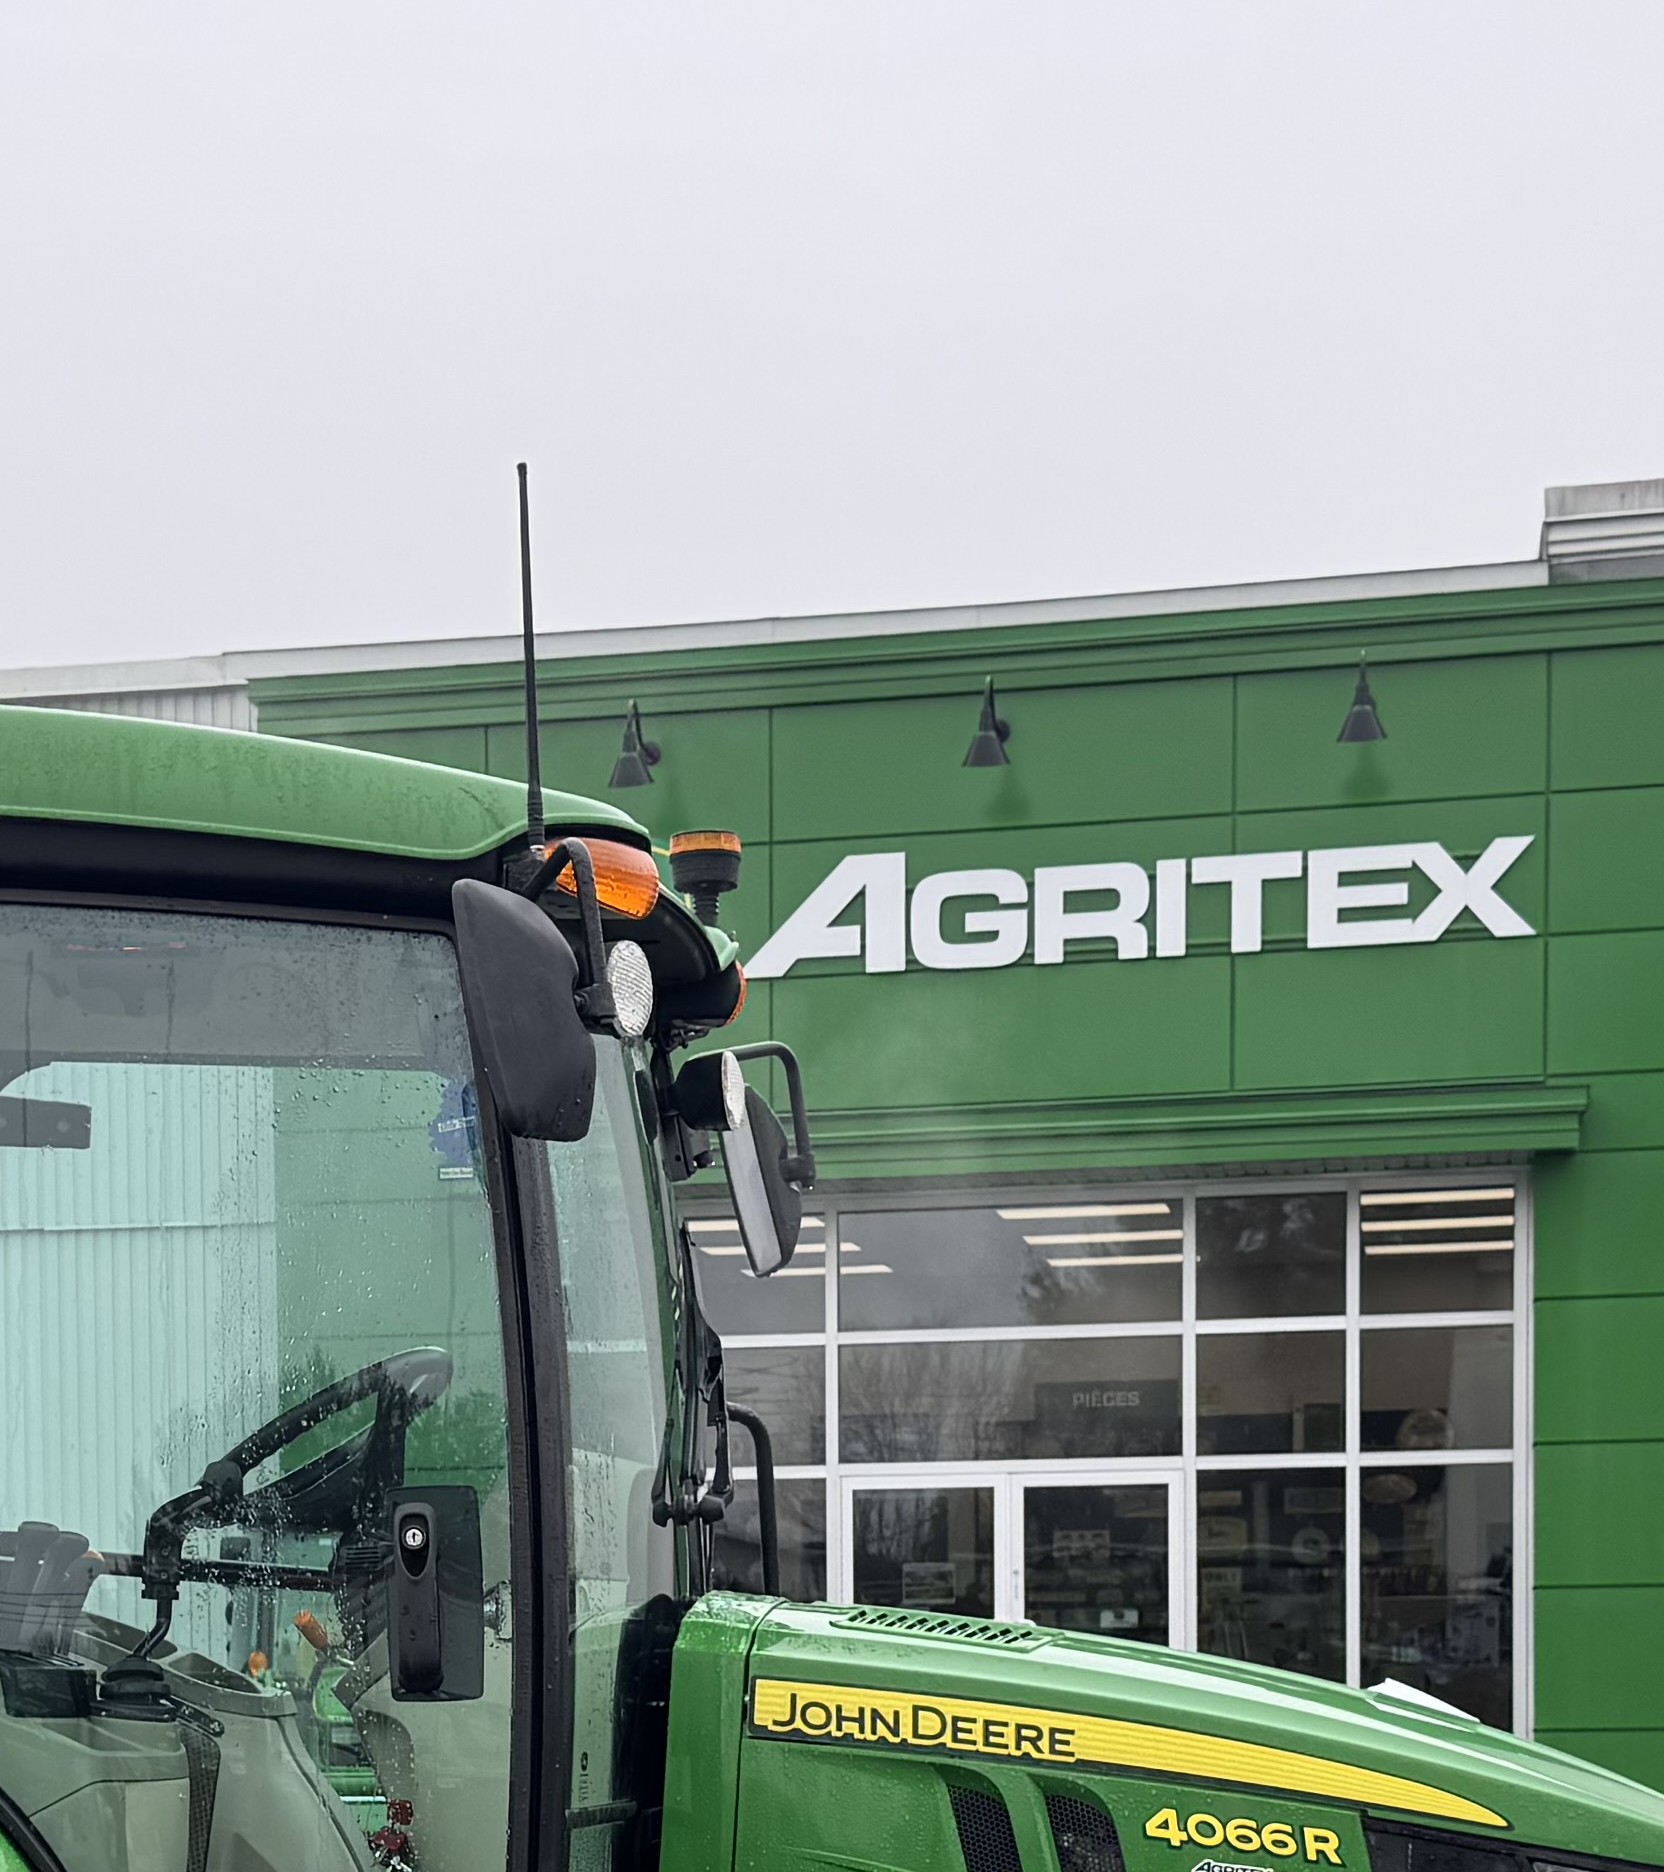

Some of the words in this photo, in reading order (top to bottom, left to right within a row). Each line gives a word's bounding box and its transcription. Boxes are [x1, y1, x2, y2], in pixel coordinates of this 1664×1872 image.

[741, 834, 1538, 979] AGRITEX
[772, 1692, 900, 1739] JOHN
[910, 1703, 1076, 1758] DEERE
